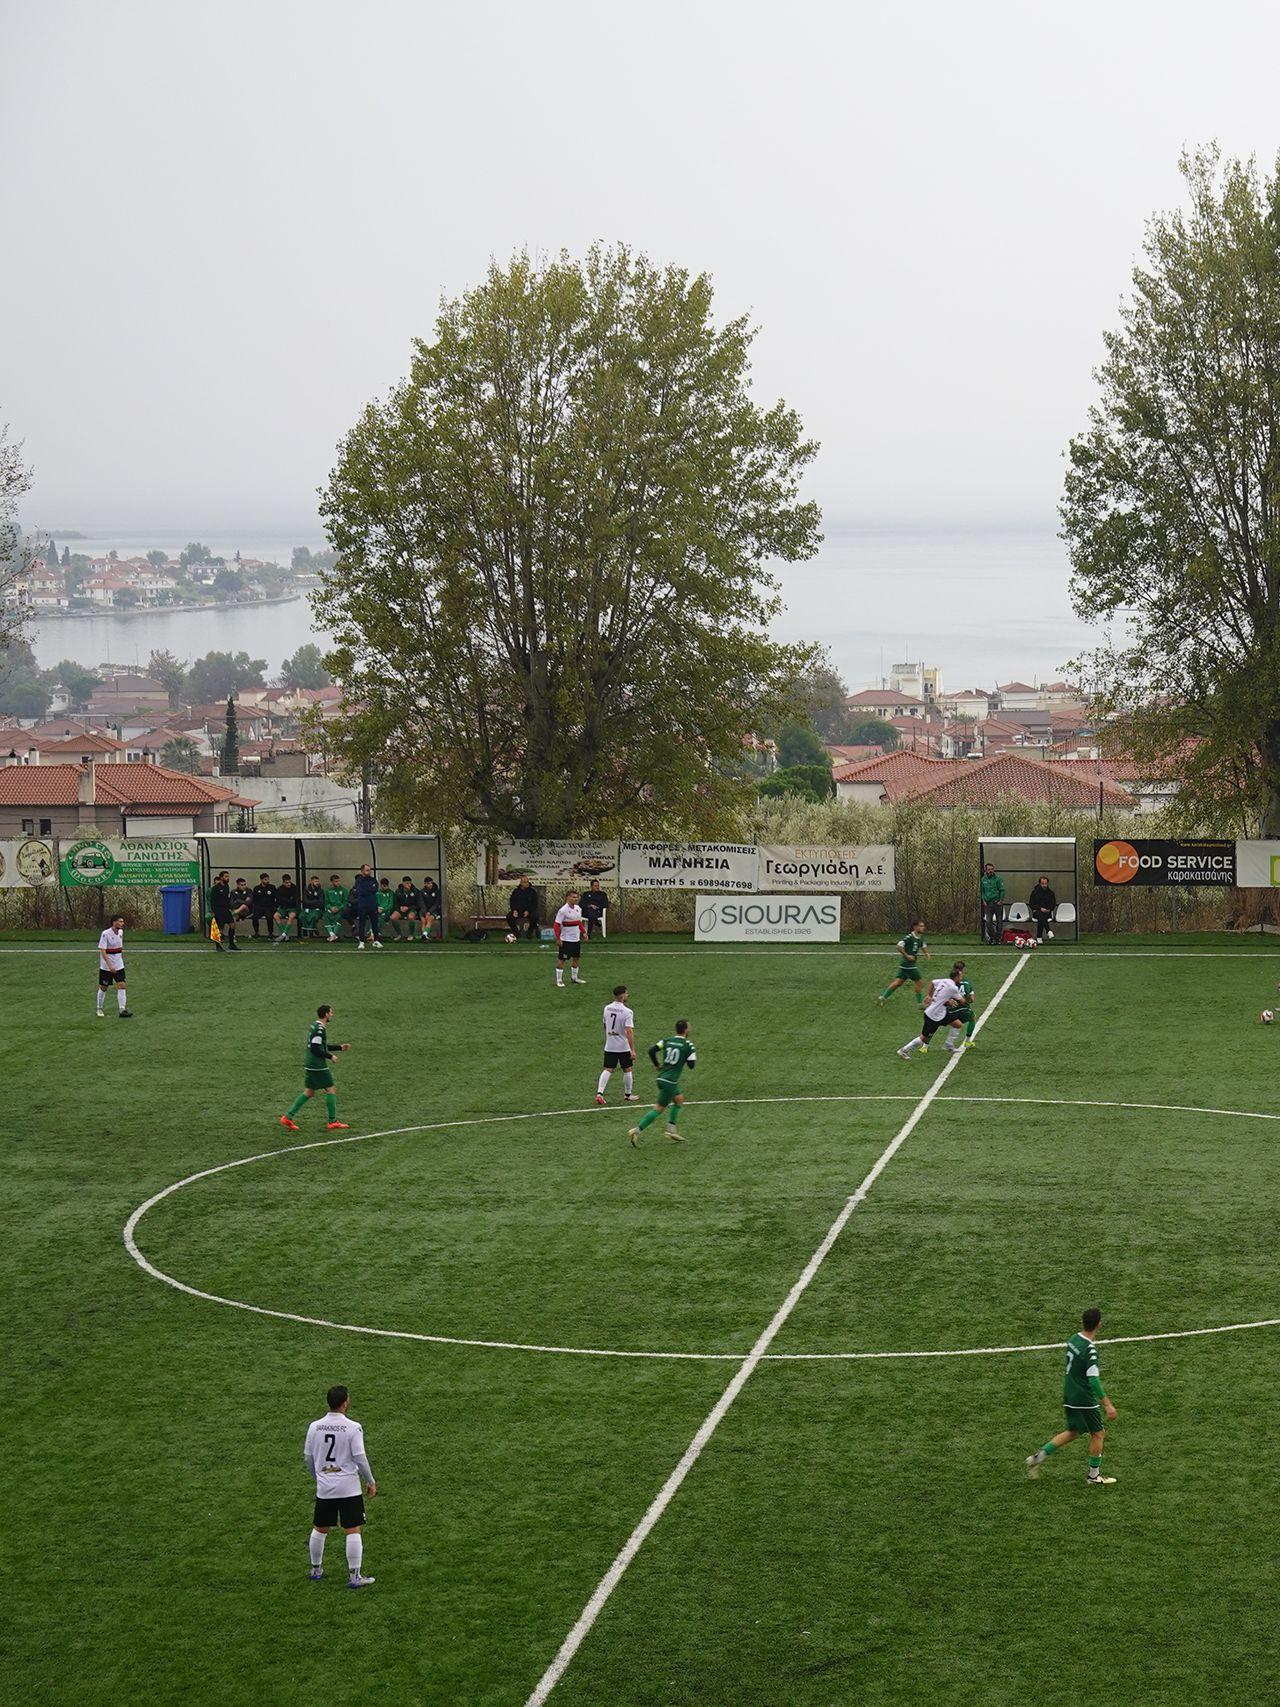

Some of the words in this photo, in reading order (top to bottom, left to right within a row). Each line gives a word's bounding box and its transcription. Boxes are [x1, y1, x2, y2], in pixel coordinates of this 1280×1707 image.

[119, 842, 190, 851] ΑΘΑΝΑΣΙΟΣ
[623, 843, 680, 851] ΜΕΤΑΦΟΡΕΣ
[687, 844, 756, 855] ΜΕΤΑΚΟΜΙΣΕΙΣ
[127, 852, 184, 861] ΓΑΝΩΤΗΣ
[794, 849, 857, 859] ΕΚΤΥΠΩΣΕΙΣ
[648, 857, 730, 870] ΜΑΓΝΗΣΙΑ
[766, 860, 860, 878] Γεωργιάδη
[1119, 855, 1162, 868] FOOD
[1167, 855, 1233, 869] SERVICE
[1167, 869, 1233, 883] καρακατσάνης
[631, 878, 676, 886] ΑΡΓΕΝΤΗ
[679, 878, 685, 886] 5
[697, 879, 753, 889] 6989487698
[721, 905, 837, 925] SIOURAS
[610, 1013, 617, 1030] 7
[664, 1046, 680, 1065] 10
[324, 1433, 336, 1462] 2
